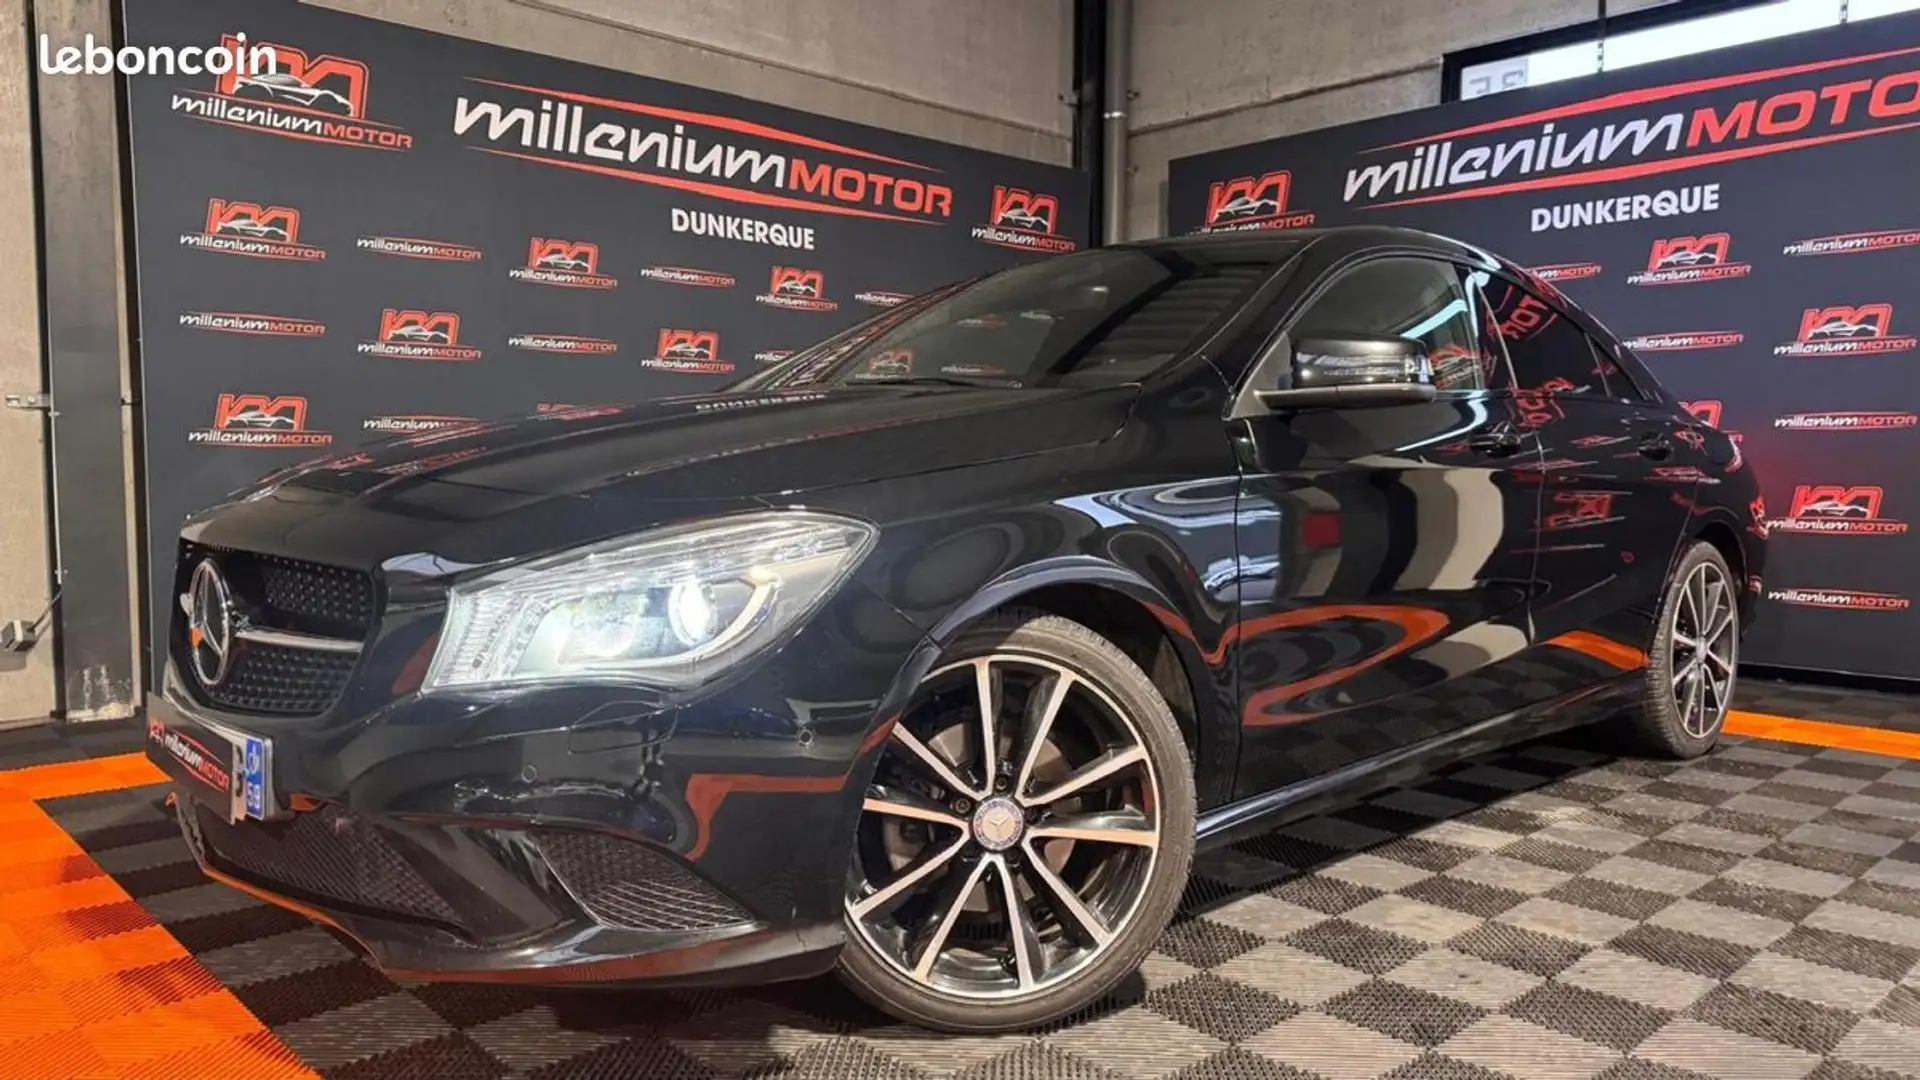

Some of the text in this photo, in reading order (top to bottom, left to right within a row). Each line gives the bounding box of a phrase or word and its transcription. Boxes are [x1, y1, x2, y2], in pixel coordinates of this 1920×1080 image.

[1343, 70, 1920, 203] milleniumMOTO
[671, 207, 815, 250] DUNKERQUE
[1531, 184, 1721, 233] DUNKERQUE
